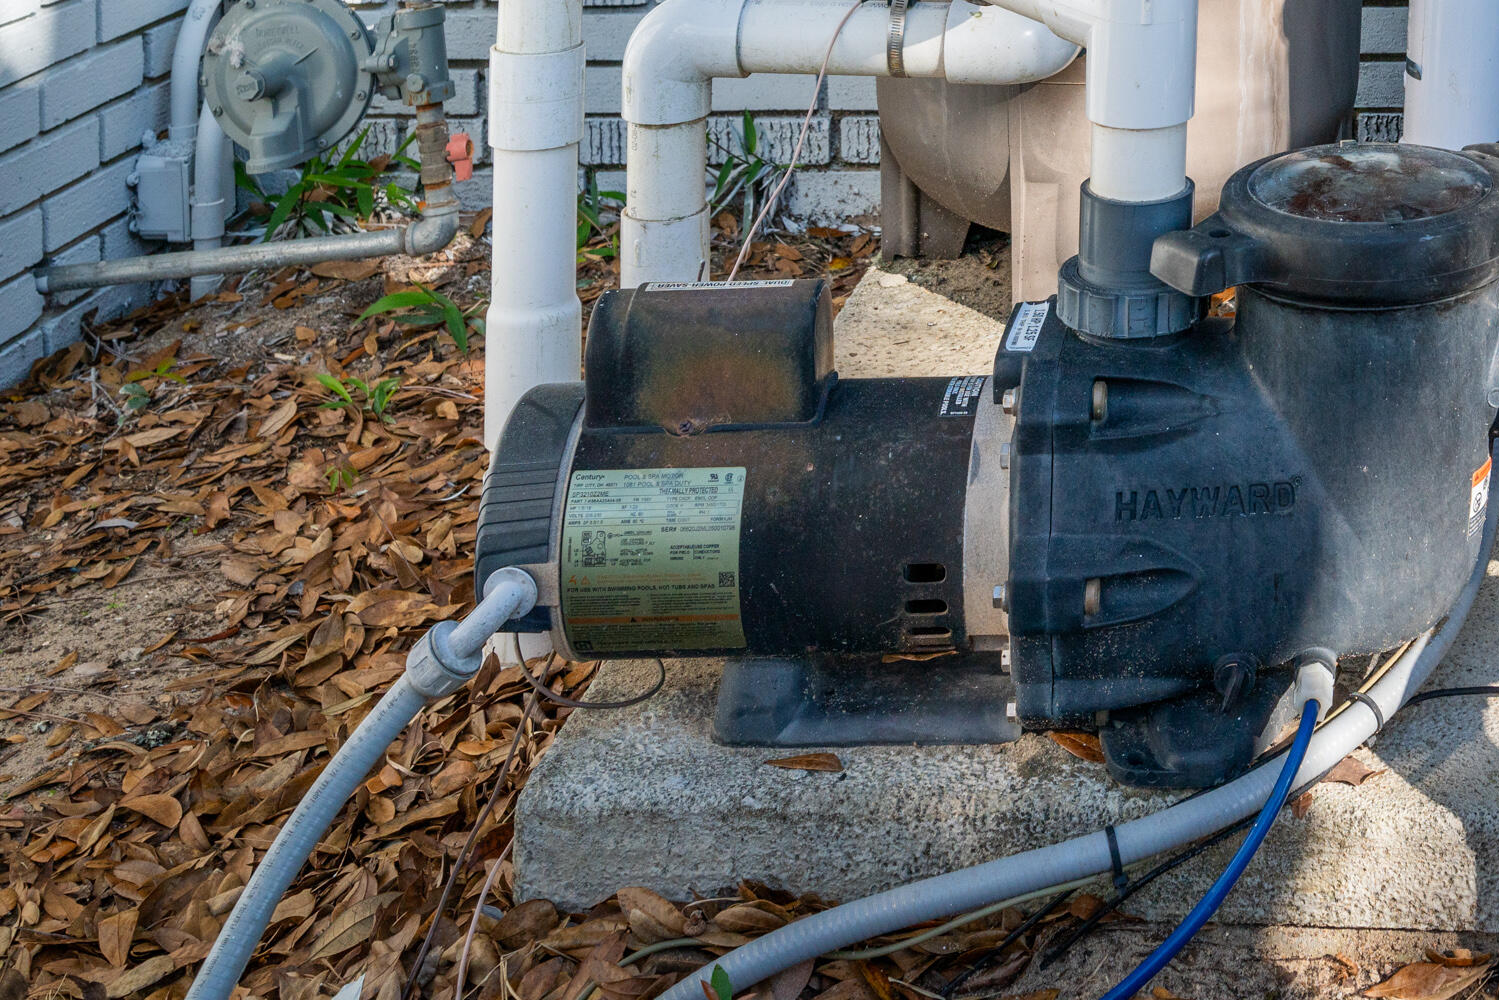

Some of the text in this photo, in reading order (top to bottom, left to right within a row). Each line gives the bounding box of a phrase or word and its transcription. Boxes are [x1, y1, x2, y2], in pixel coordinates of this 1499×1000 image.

[575, 473, 603, 482] Century
[689, 486, 719, 494] PROTECTED
[1114, 481, 1297, 521] HAYWARD
